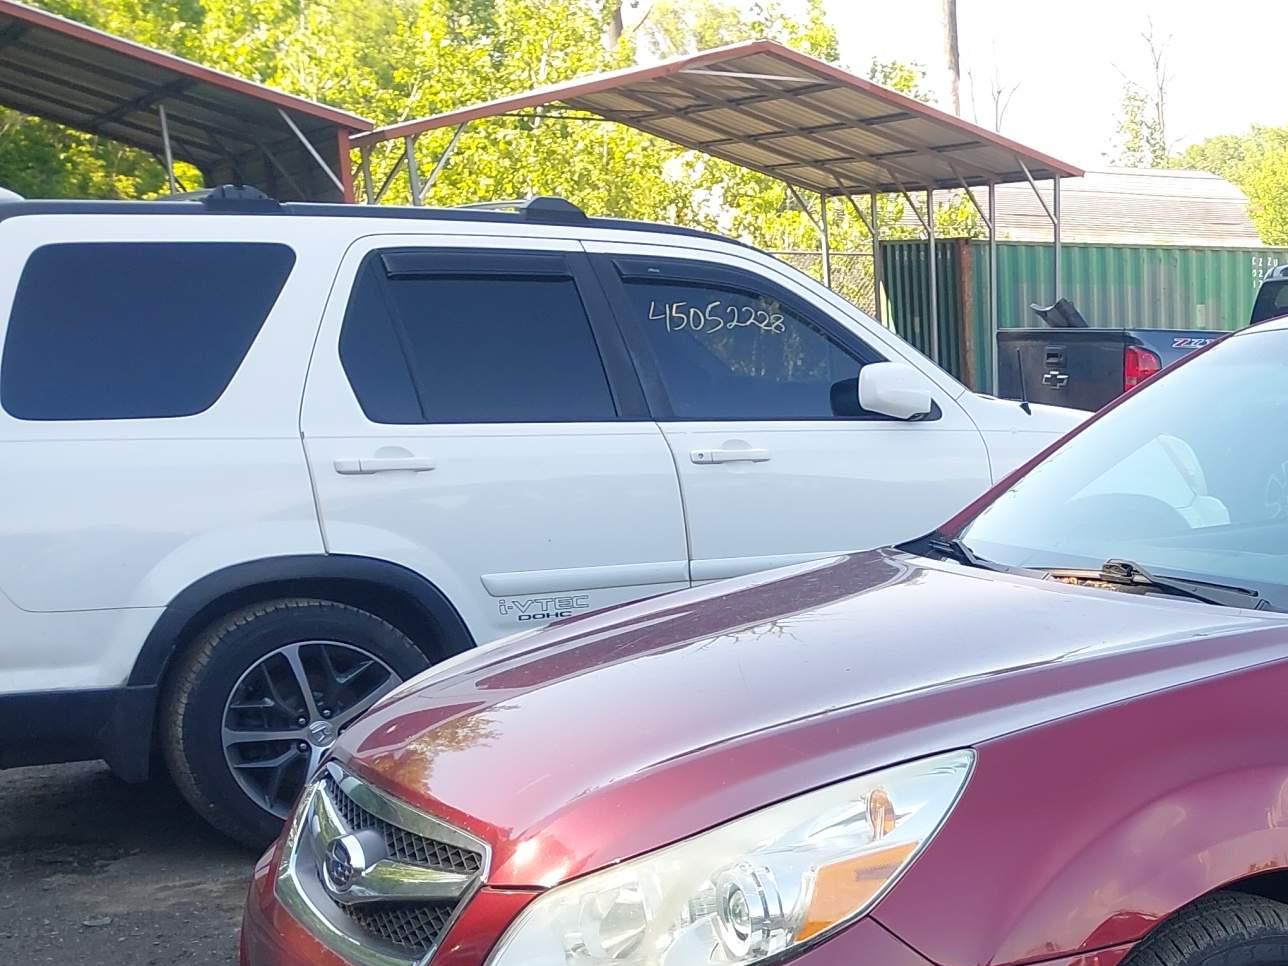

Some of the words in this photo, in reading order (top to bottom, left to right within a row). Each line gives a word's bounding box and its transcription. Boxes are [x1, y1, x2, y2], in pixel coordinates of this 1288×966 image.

[648, 301, 786, 333] 45052228
[498, 595, 590, 615] i-VTEC
[518, 611, 572, 621] DOHC
